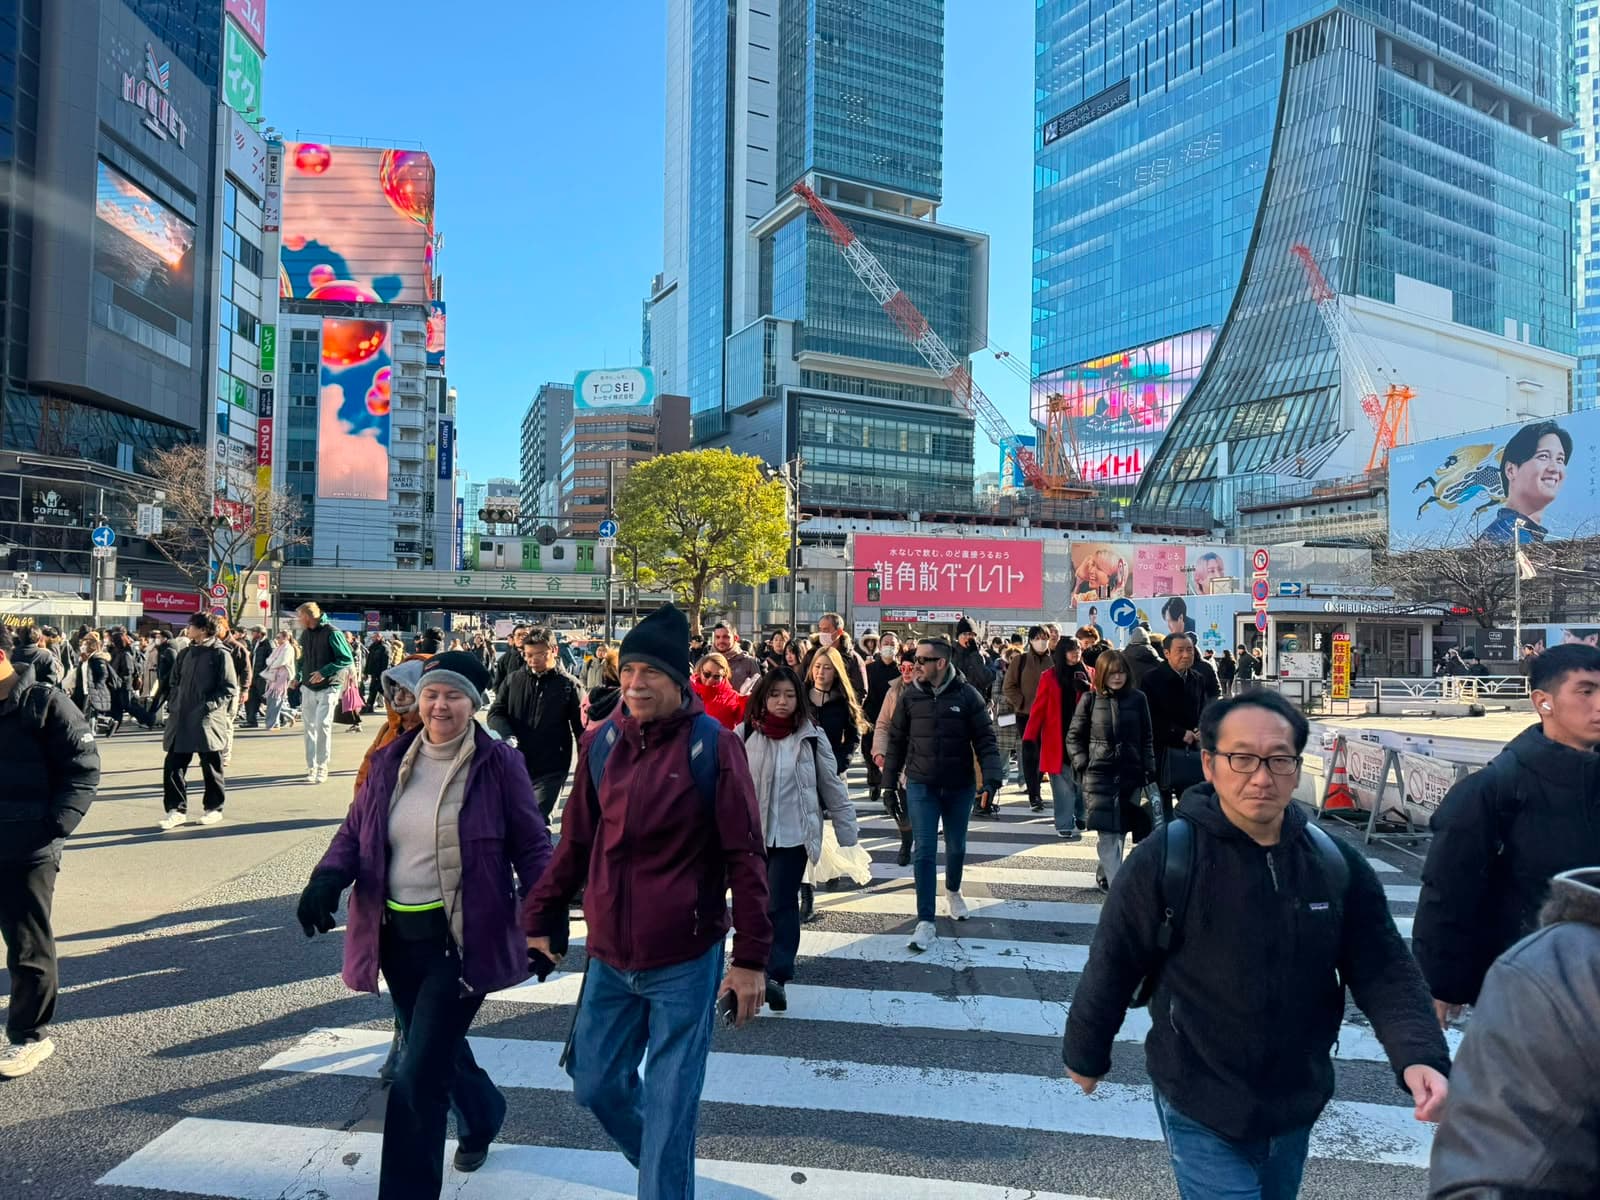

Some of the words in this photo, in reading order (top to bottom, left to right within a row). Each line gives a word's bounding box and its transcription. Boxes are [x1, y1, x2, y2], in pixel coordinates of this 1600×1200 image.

[1059, 110, 1096, 134] SCRAMBLE
[1097, 91, 1128, 114] SQUARE
[1059, 104, 1090, 124] SHIBUYA
[263, 329, 273, 353] レイク
[593, 382, 635, 394] TOSEI
[32, 506, 70, 517] COFFEE
[889, 549, 1010, 560] 水なしで飲む、のど直接うるおう
[454, 575, 471, 587] JR
[872, 560, 1025, 593] 龍角散ダイレクト
[1335, 602, 1358, 613] SHIBU
[1333, 643, 1345, 695] 駐停車禁止
